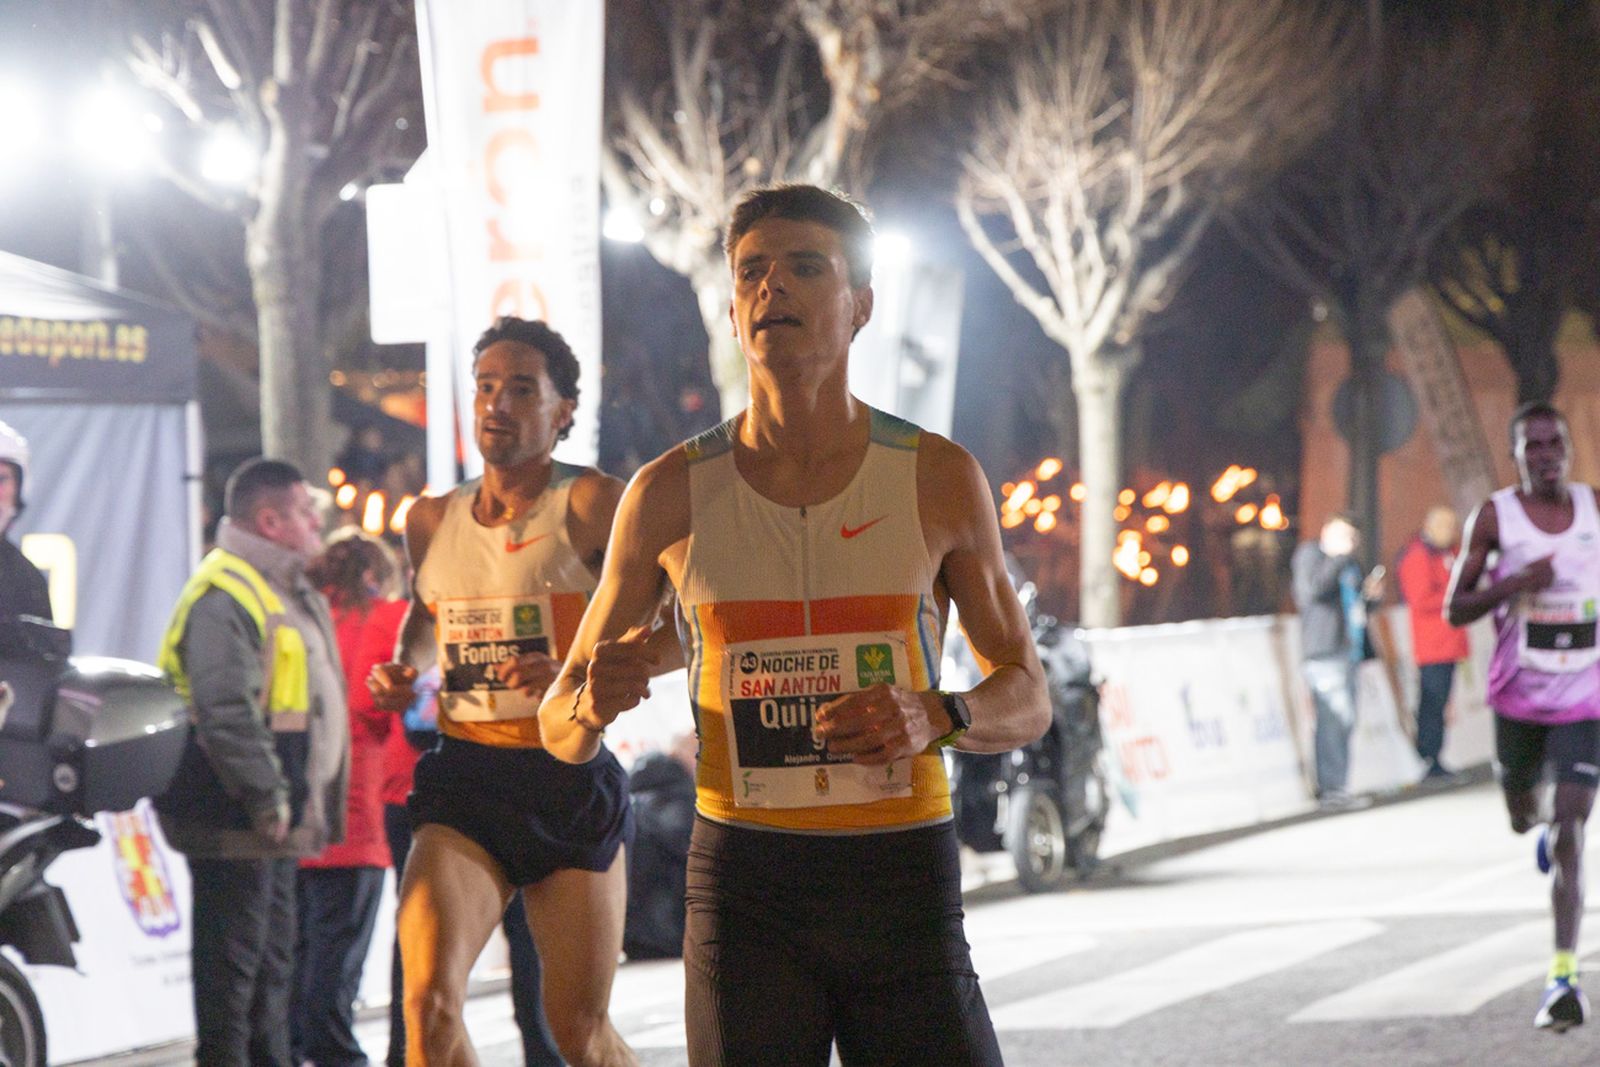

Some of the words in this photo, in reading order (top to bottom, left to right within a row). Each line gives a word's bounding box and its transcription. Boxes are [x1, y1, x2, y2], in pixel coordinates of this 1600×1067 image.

[459, 642, 520, 665] Fontes
[761, 656, 815, 674] NOCHE
[819, 654, 840, 671] DE
[741, 676, 776, 697] SAN
[780, 670, 841, 696] ANTÓN
[760, 696, 817, 737] Quij
